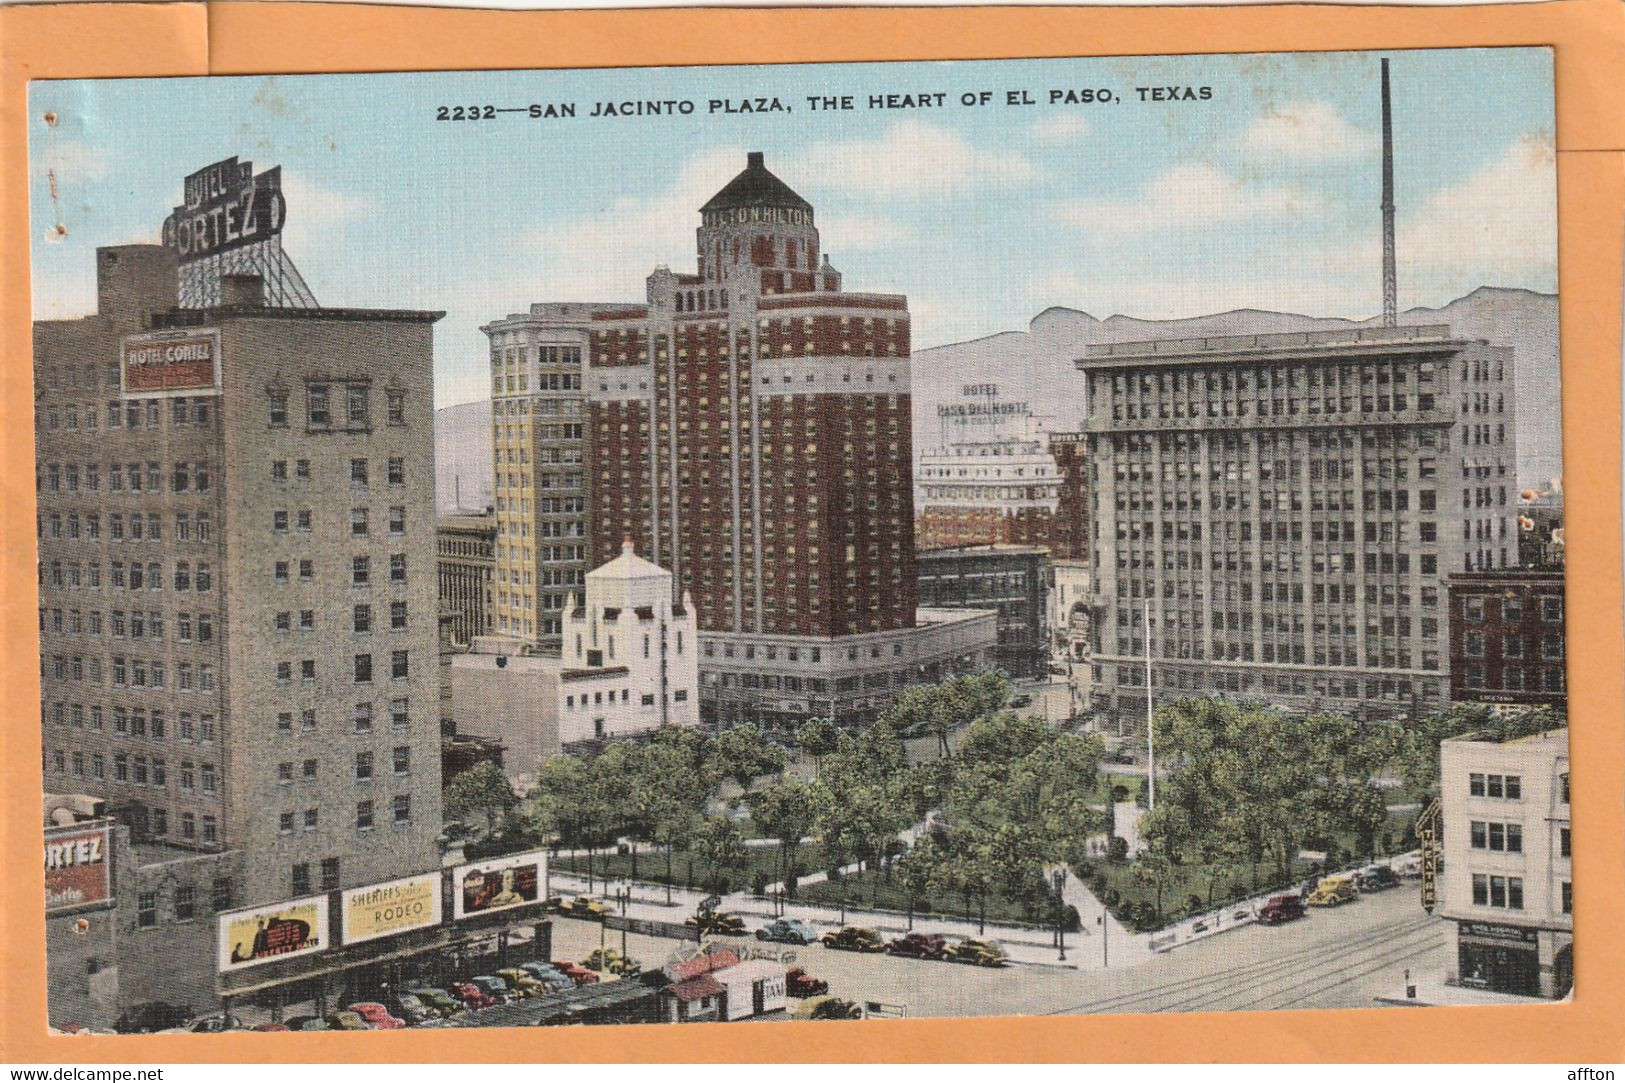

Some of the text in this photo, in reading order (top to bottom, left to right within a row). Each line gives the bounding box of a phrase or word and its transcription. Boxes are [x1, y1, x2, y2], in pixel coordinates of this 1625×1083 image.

[590, 100, 695, 117] JACINTO
[708, 97, 792, 114] PLAZA,
[806, 95, 854, 111] THE
[868, 92, 947, 109] HEART
[960, 91, 993, 107] OF
[1006, 90, 1036, 106] EL
[1049, 88, 1120, 105] PASO,
[1135, 86, 1213, 102] TEXAS
[186, 165, 228, 212] HOTEL
[165, 180, 258, 257] CORTEZ
[963, 383, 999, 396] HOTEL
[1423, 828, 1436, 901] THEATRE
[375, 902, 423, 923] RODEO
[764, 982, 785, 999] TAXI
